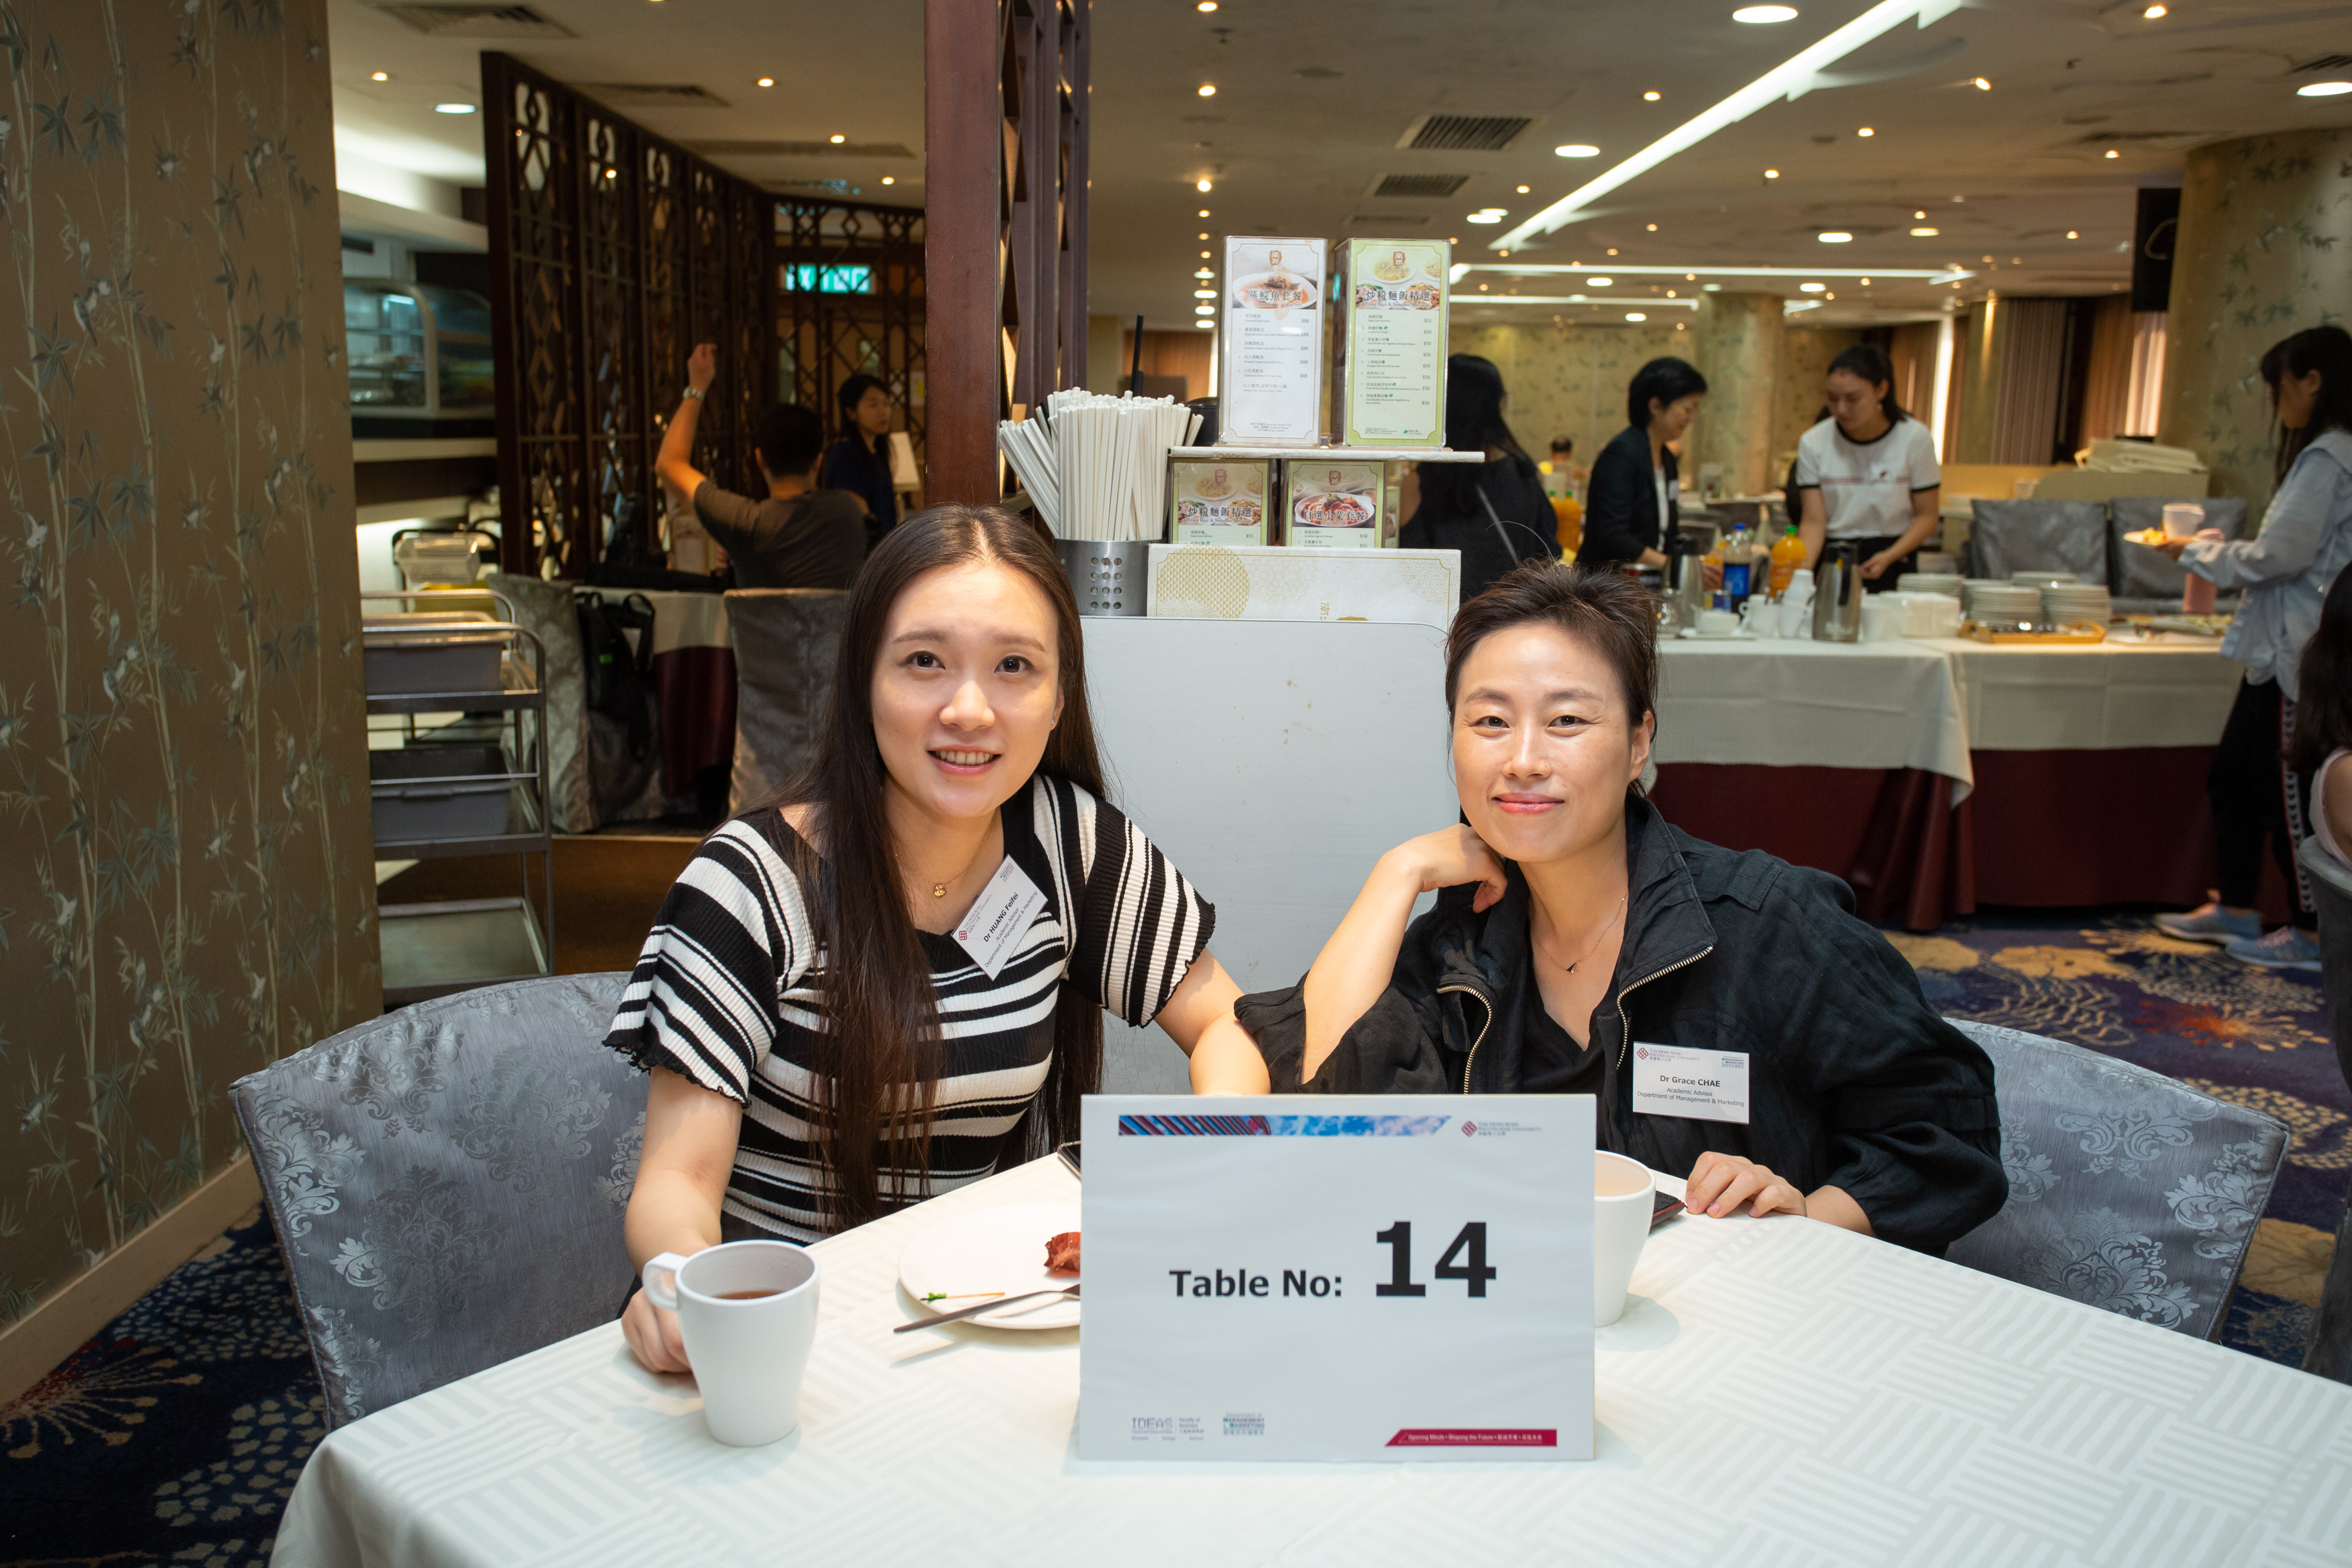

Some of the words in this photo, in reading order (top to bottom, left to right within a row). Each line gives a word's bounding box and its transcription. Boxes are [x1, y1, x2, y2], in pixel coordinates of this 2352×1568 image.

[1366, 290, 1430, 300] 炒粉麵飯精選
[1188, 507, 1252, 517] 炒粉麵飯精選
[1304, 511, 1365, 520] 自選小菜套餐
[983, 934, 991, 942] Dr
[989, 910, 1007, 934] HUANG
[1005, 892, 1019, 911] Feifei
[984, 943, 1002, 967] Department
[1004, 914, 1022, 940] Management
[1023, 891, 1038, 910] Marketing
[995, 921, 1010, 941] Academic
[1008, 907, 1020, 922] Advisor
[1672, 1076, 1696, 1085] Grace
[1637, 1091, 1668, 1099] Department
[1170, 1269, 1269, 1297] Table
[1284, 1271, 1341, 1297] No:
[1377, 1221, 1496, 1298] 14
[1132, 1417, 1173, 1429] IDEAS
